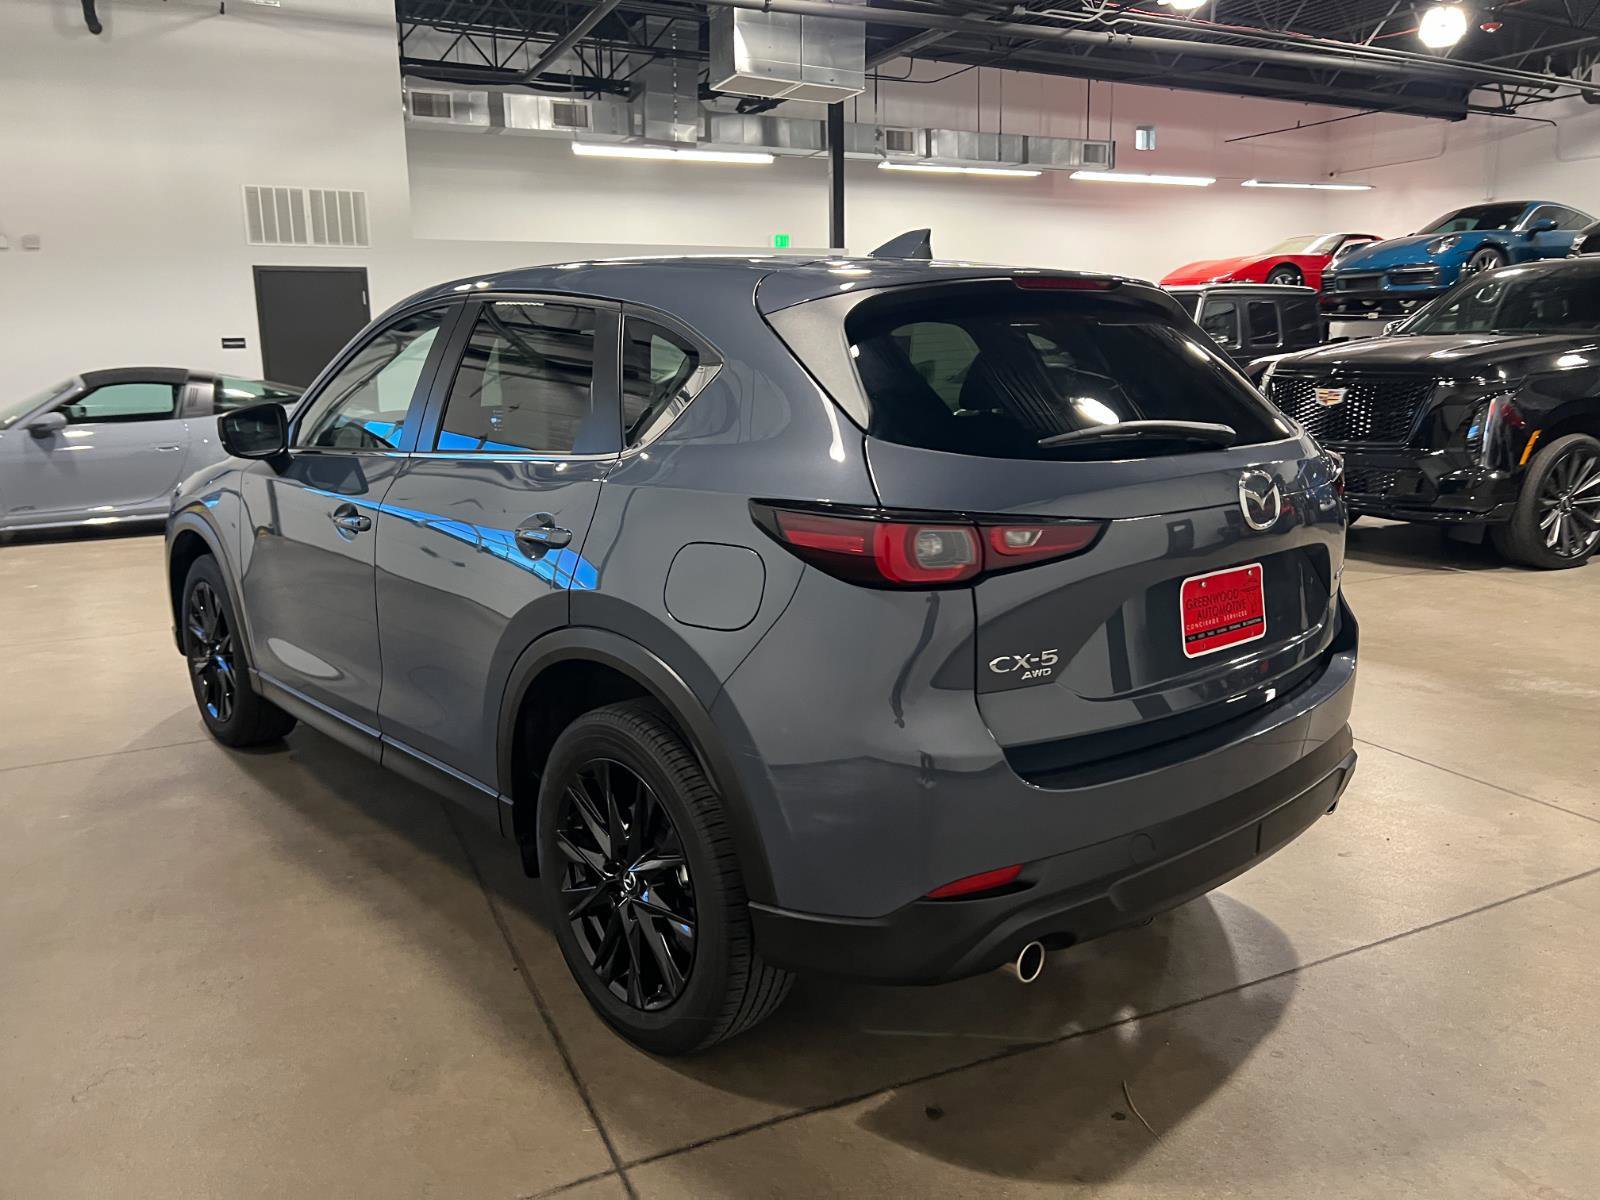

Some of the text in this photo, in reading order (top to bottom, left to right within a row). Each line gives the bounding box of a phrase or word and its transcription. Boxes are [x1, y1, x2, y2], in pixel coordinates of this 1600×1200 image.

[1185, 588, 1239, 610] GREENWOOD
[1197, 599, 1247, 620] AUTOMOTIVE
[989, 649, 1059, 673] CX-5
[1021, 668, 1052, 680] AWD
